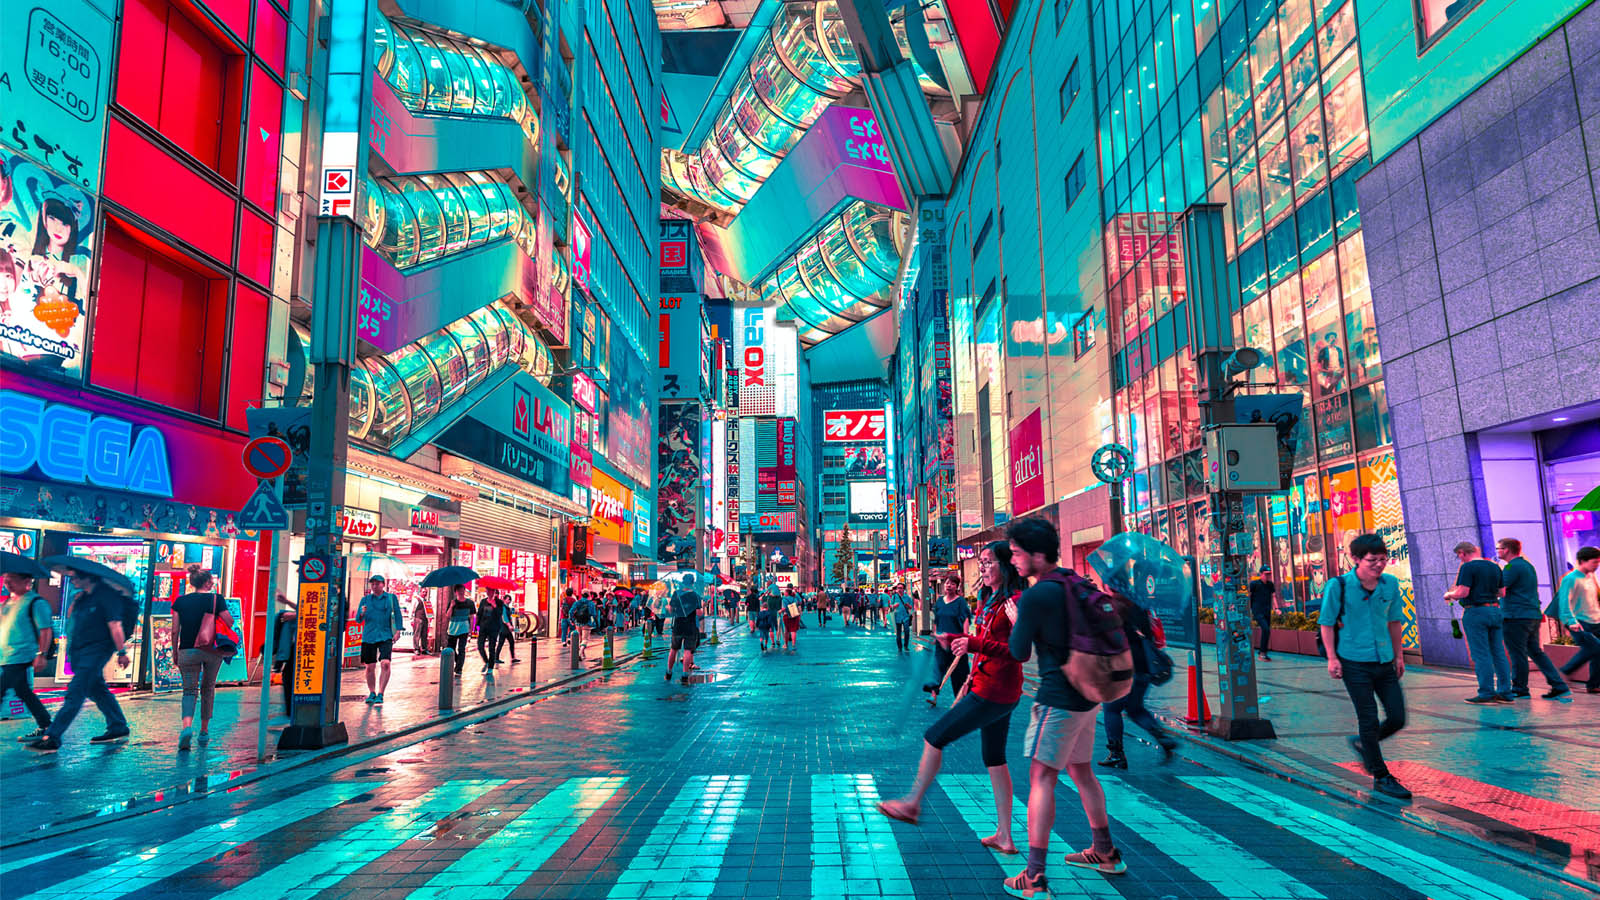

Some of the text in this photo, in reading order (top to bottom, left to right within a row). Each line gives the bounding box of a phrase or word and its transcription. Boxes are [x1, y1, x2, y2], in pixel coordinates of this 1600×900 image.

[40, 31, 91, 79] 16:00
[43, 18, 90, 61] 営業時間
[31, 68, 90, 116] 翌5:00
[0, 119, 91, 188] らです。
[0, 389, 174, 497] SEGA
[534, 396, 568, 448] LABI
[783, 420, 794, 466] Duty Free
[1015, 444, 1036, 484] atré
[421, 510, 439, 527] LABI
[859, 513, 884, 521] TOKYO
[302, 590, 319, 691] 路上喫煙禁止です。
[348, 625, 363, 636] au
